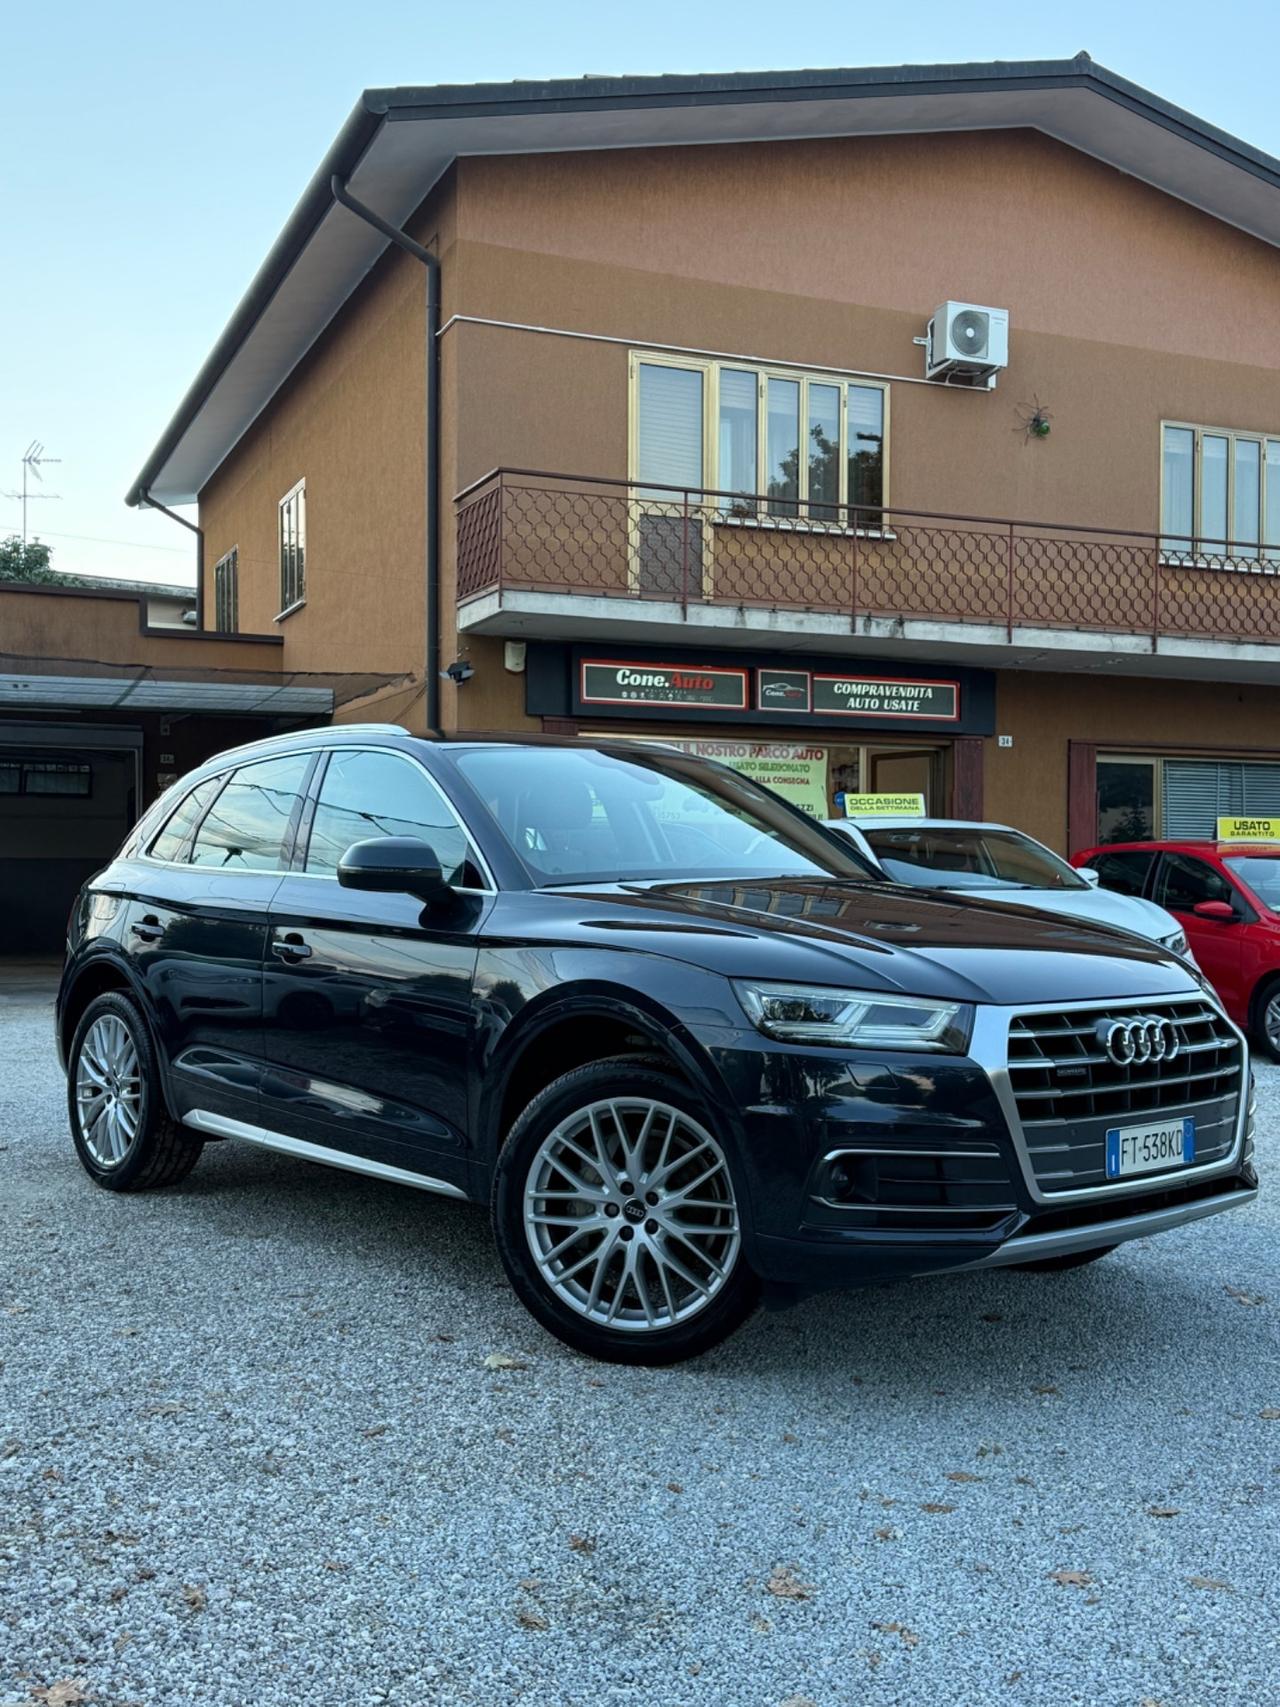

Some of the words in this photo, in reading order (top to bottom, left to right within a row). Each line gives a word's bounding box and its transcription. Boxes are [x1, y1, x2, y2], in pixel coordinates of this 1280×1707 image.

[616, 668, 714, 690] Cone.Auto
[834, 682, 933, 698] COMPRAVENDITA
[846, 697, 879, 710] AUTO
[884, 699, 920, 712] USATE
[696, 743, 747, 758] NOSTRO
[749, 744, 791, 759] PARCO
[792, 747, 824, 761] AUTO
[773, 776, 810, 786] CONSEGNA
[849, 798, 919, 806] OCCASIONE
[1233, 820, 1271, 831] USATO
